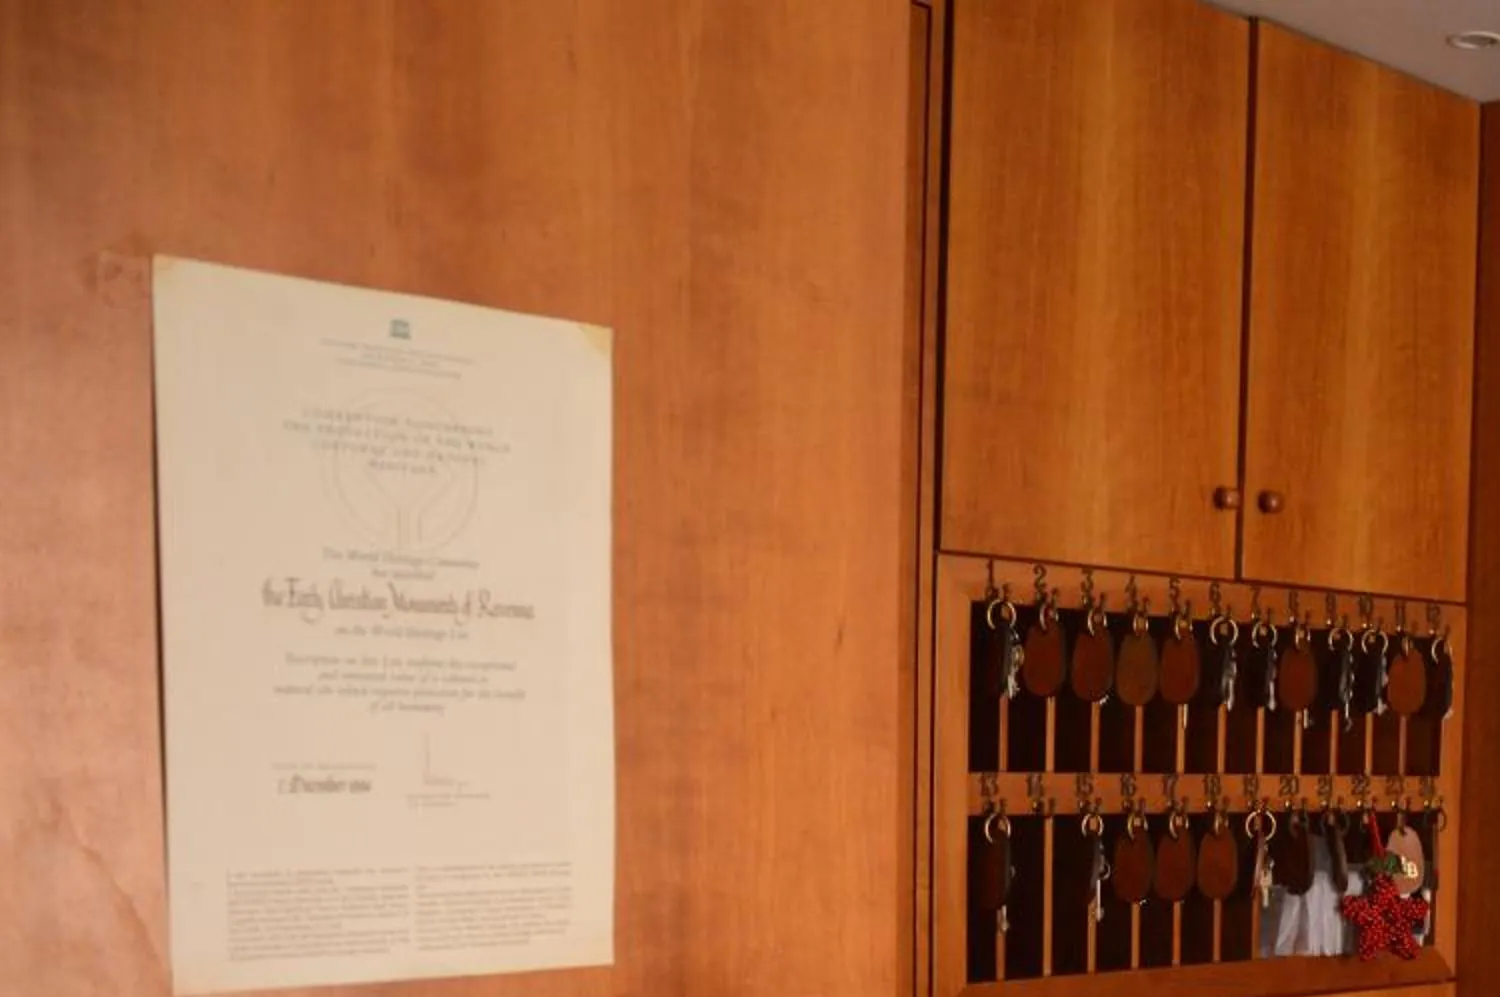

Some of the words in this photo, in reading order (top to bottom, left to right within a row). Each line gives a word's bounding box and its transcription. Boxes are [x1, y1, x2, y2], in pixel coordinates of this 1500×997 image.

[1033, 564, 1047, 589] 2
[1081, 567, 1094, 593] 3
[1126, 573, 1138, 597] 4
[1169, 576, 1180, 600] 5
